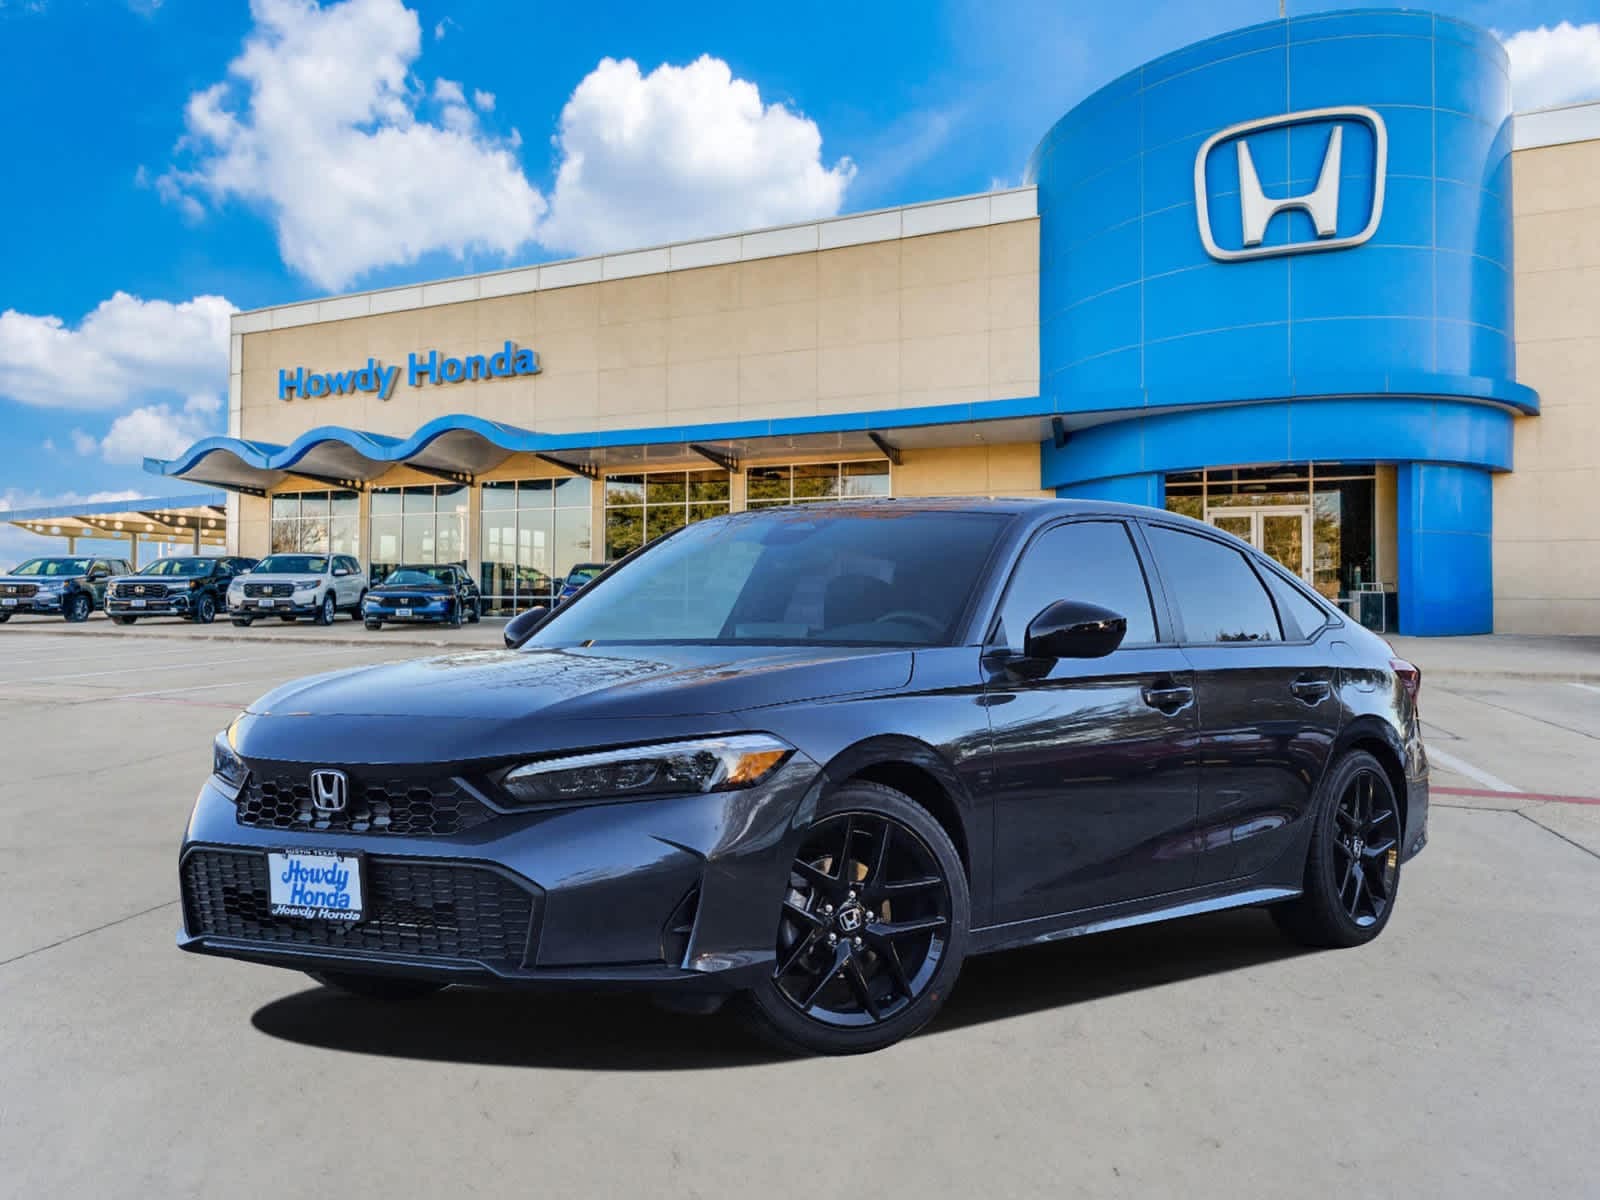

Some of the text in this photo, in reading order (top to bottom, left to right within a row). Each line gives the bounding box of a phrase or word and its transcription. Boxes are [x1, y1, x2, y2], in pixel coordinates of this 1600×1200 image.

[278, 340, 541, 401] Howdy Honda
[281, 859, 349, 892] Howdy
[290, 883, 351, 909] Honda
[271, 904, 361, 921] Howdy Honda
